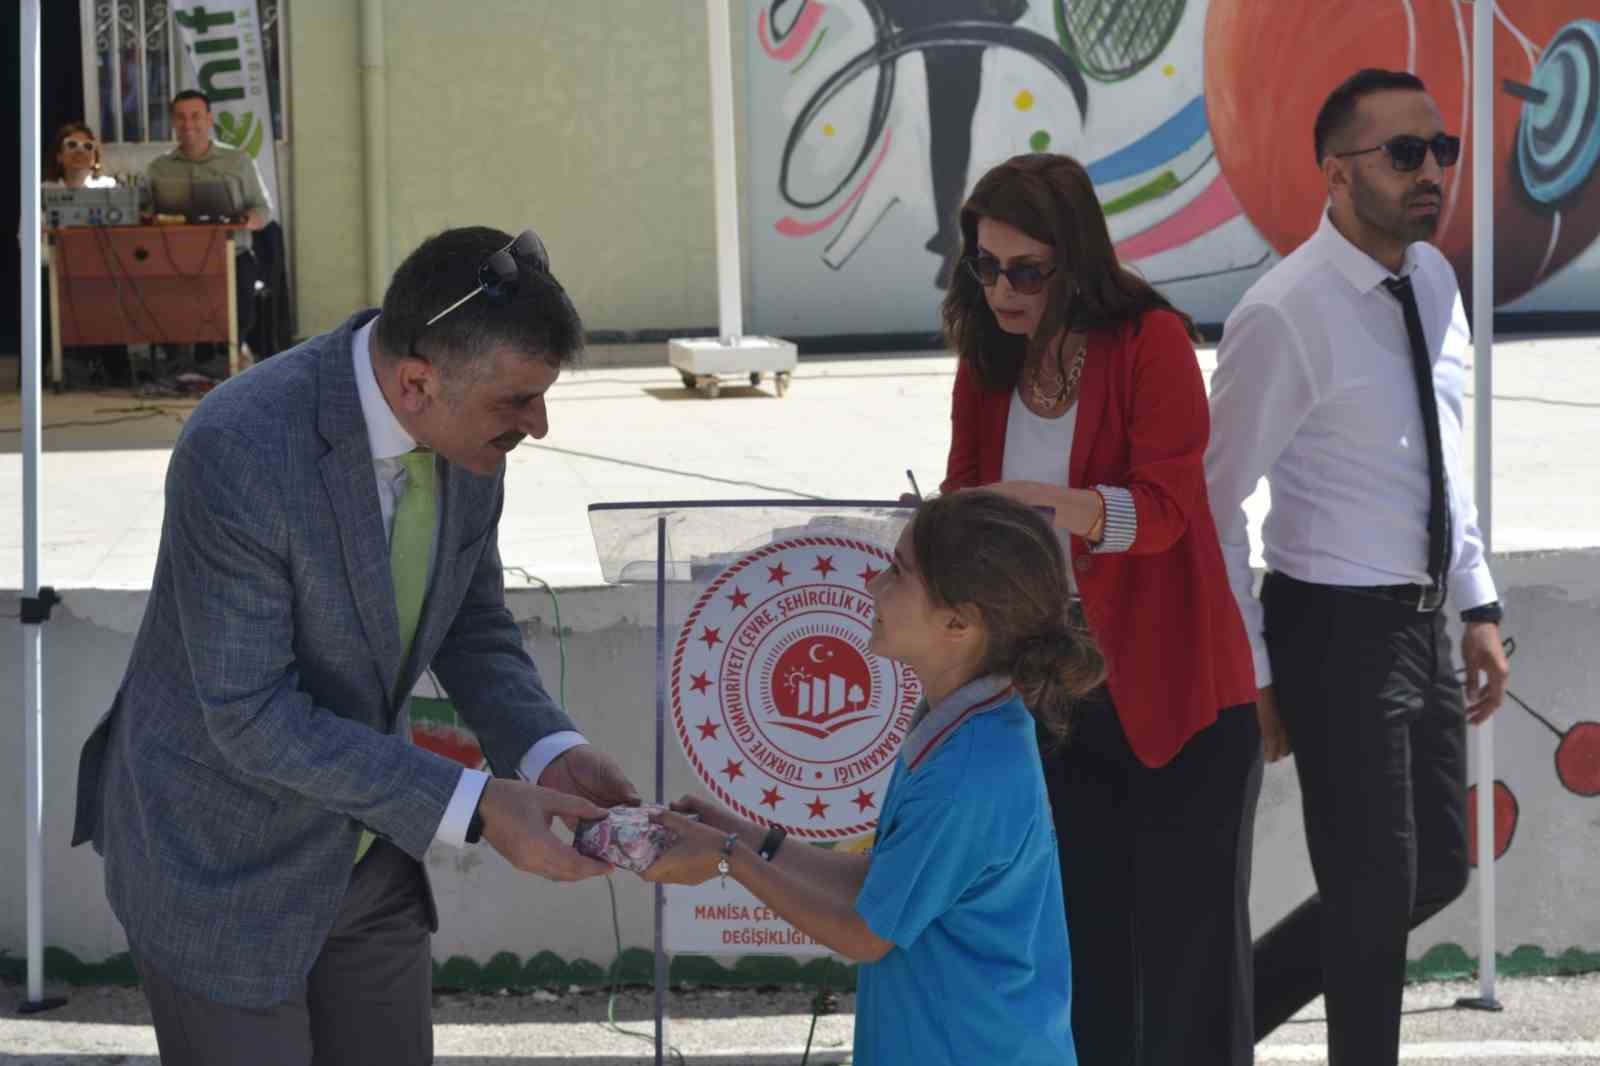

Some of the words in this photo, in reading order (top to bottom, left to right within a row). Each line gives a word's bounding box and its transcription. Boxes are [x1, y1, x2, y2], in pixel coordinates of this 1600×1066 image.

[776, 588, 855, 617] ŞEHİRCİLİK
[856, 601, 873, 619] VE
[738, 609, 779, 648] ÇEVRE,
[722, 646, 755, 743] CUMHURİYETİ
[750, 741, 804, 782] TÜRKİYE
[834, 731, 902, 784] BAKANLIĞI
[694, 903, 750, 921] MANİSA
